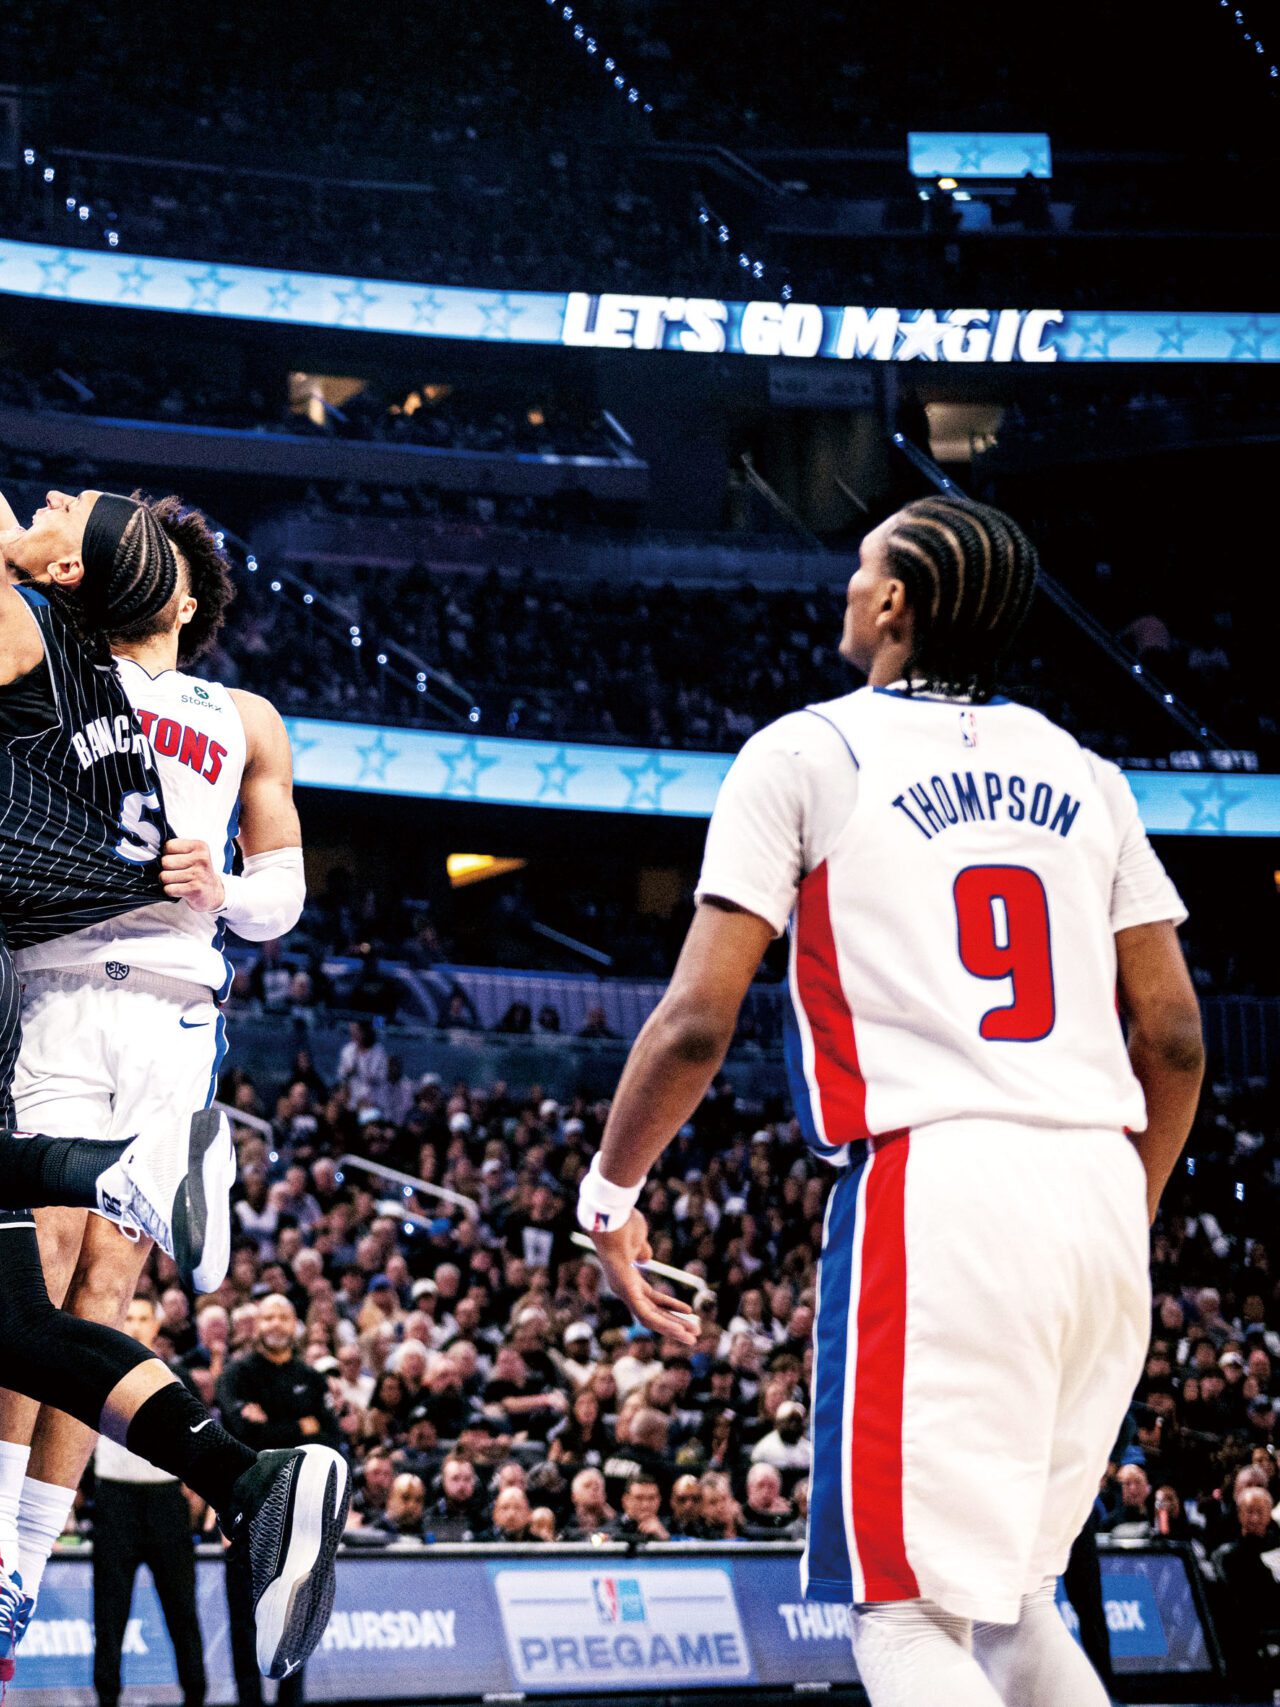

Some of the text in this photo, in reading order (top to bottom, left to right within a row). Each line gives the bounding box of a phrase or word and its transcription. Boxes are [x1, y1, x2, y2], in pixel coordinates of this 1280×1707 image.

[561, 292, 727, 353] LET'S
[740, 301, 823, 357] GO
[131, 707, 228, 786] TONS
[112, 787, 161, 867] 5
[891, 771, 1081, 840] THOMPSON
[952, 863, 1057, 1043] 9
[320, 1609, 456, 1650] HURSDAY
[519, 1632, 742, 1670] PREGAME
[777, 1602, 852, 1640] THUR
